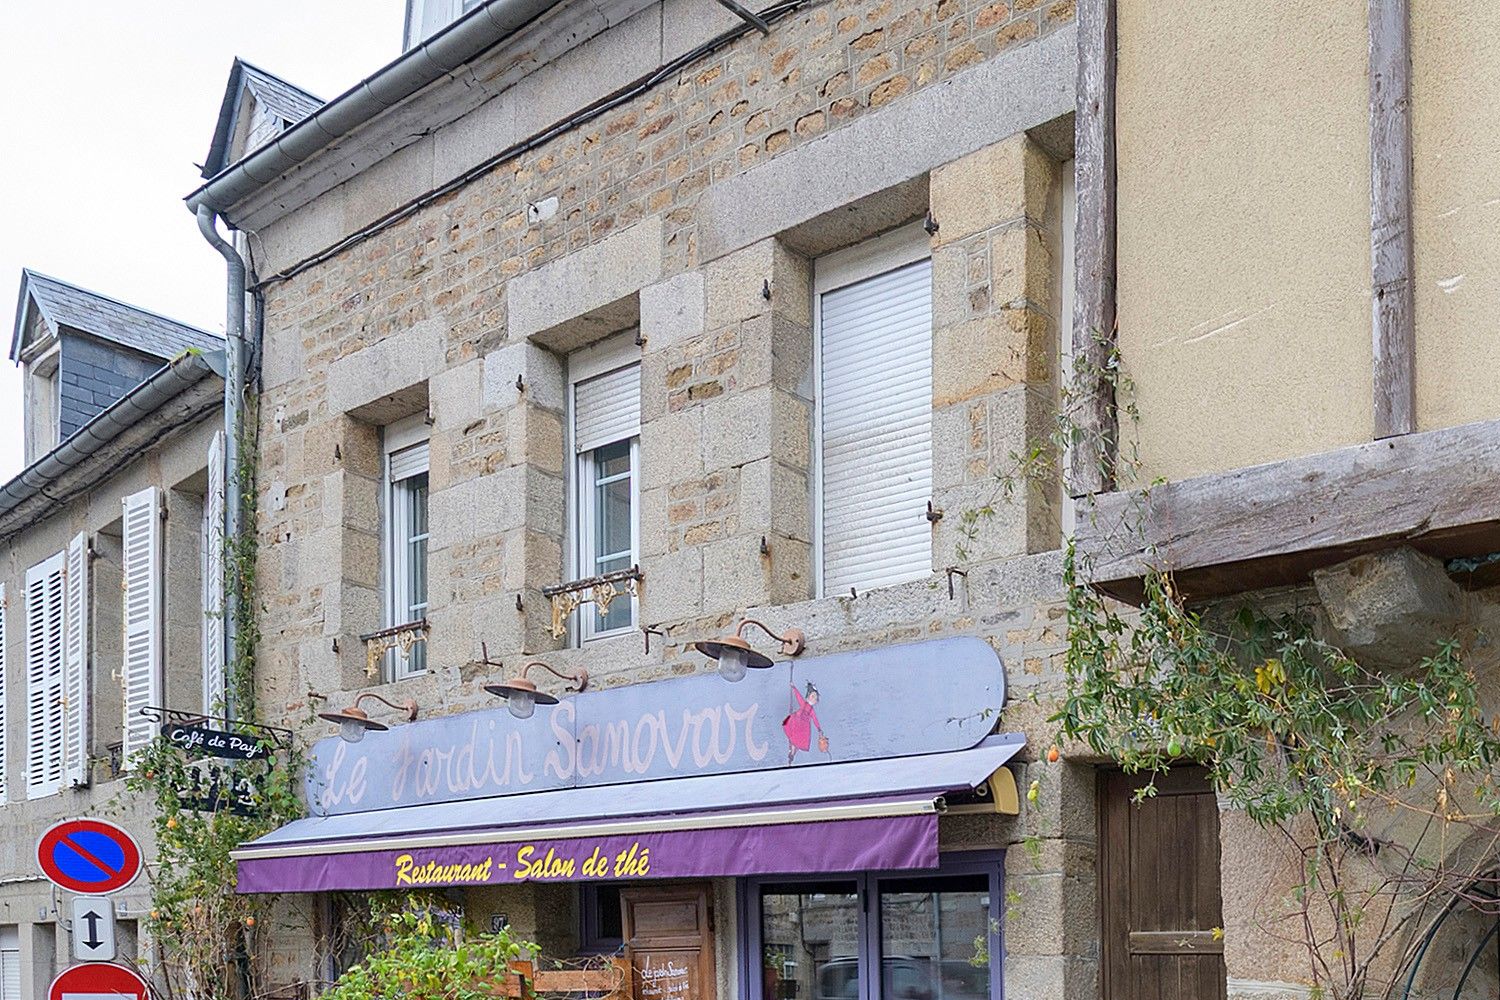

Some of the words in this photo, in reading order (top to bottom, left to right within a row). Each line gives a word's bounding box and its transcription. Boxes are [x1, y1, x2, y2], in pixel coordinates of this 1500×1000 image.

[171, 729, 204, 749] Café
[208, 736, 225, 748] de
[229, 737, 263, 758] Pays
[322, 740, 367, 808] Le
[391, 719, 534, 801] Jardin
[395, 854, 492, 885] Restaurant
[514, 845, 575, 879] Salon
[582, 847, 608, 877] de
[614, 842, 650, 877] thé
